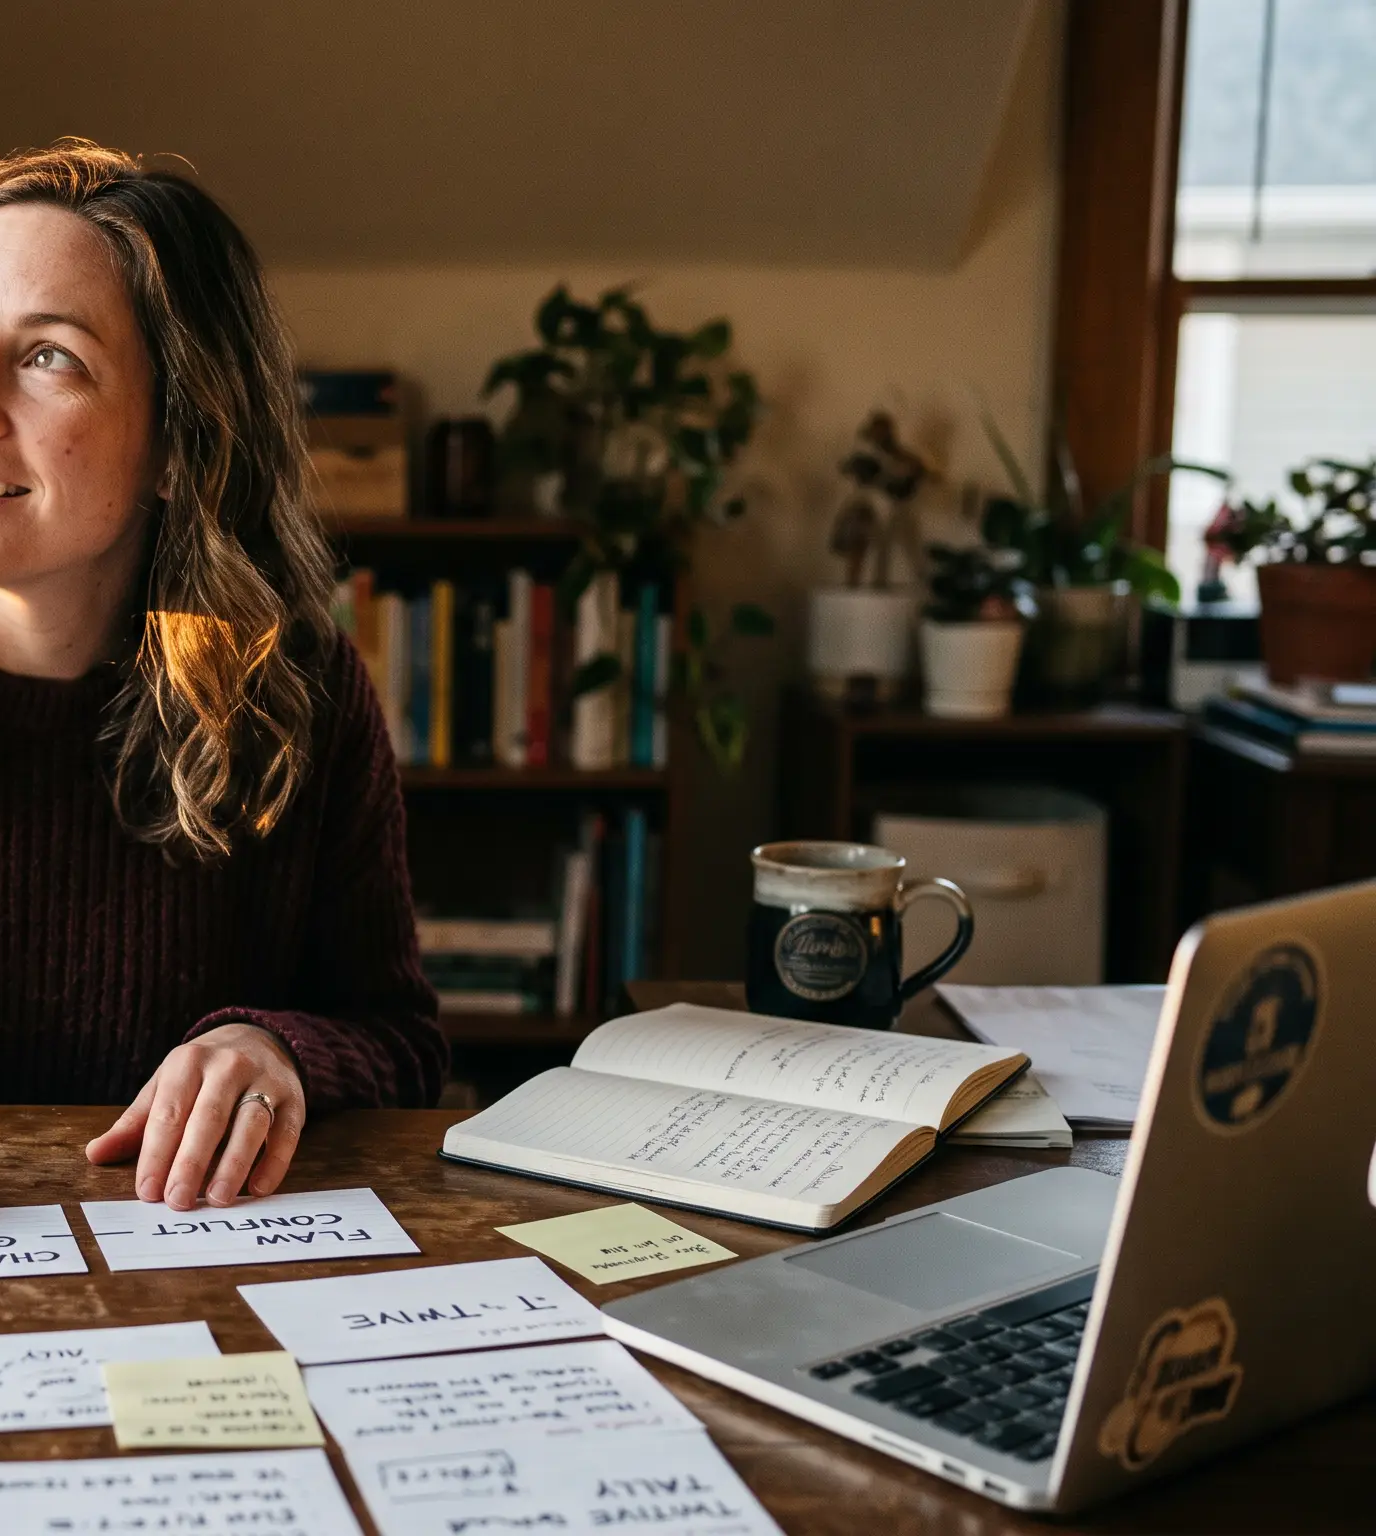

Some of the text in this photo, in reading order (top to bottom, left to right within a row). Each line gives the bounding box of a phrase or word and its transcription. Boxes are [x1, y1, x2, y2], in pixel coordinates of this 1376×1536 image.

[152, 1213, 343, 1236] CONFLICT
[256, 1229, 372, 1246] FLAW
[596, 1475, 713, 1498] TALLY
